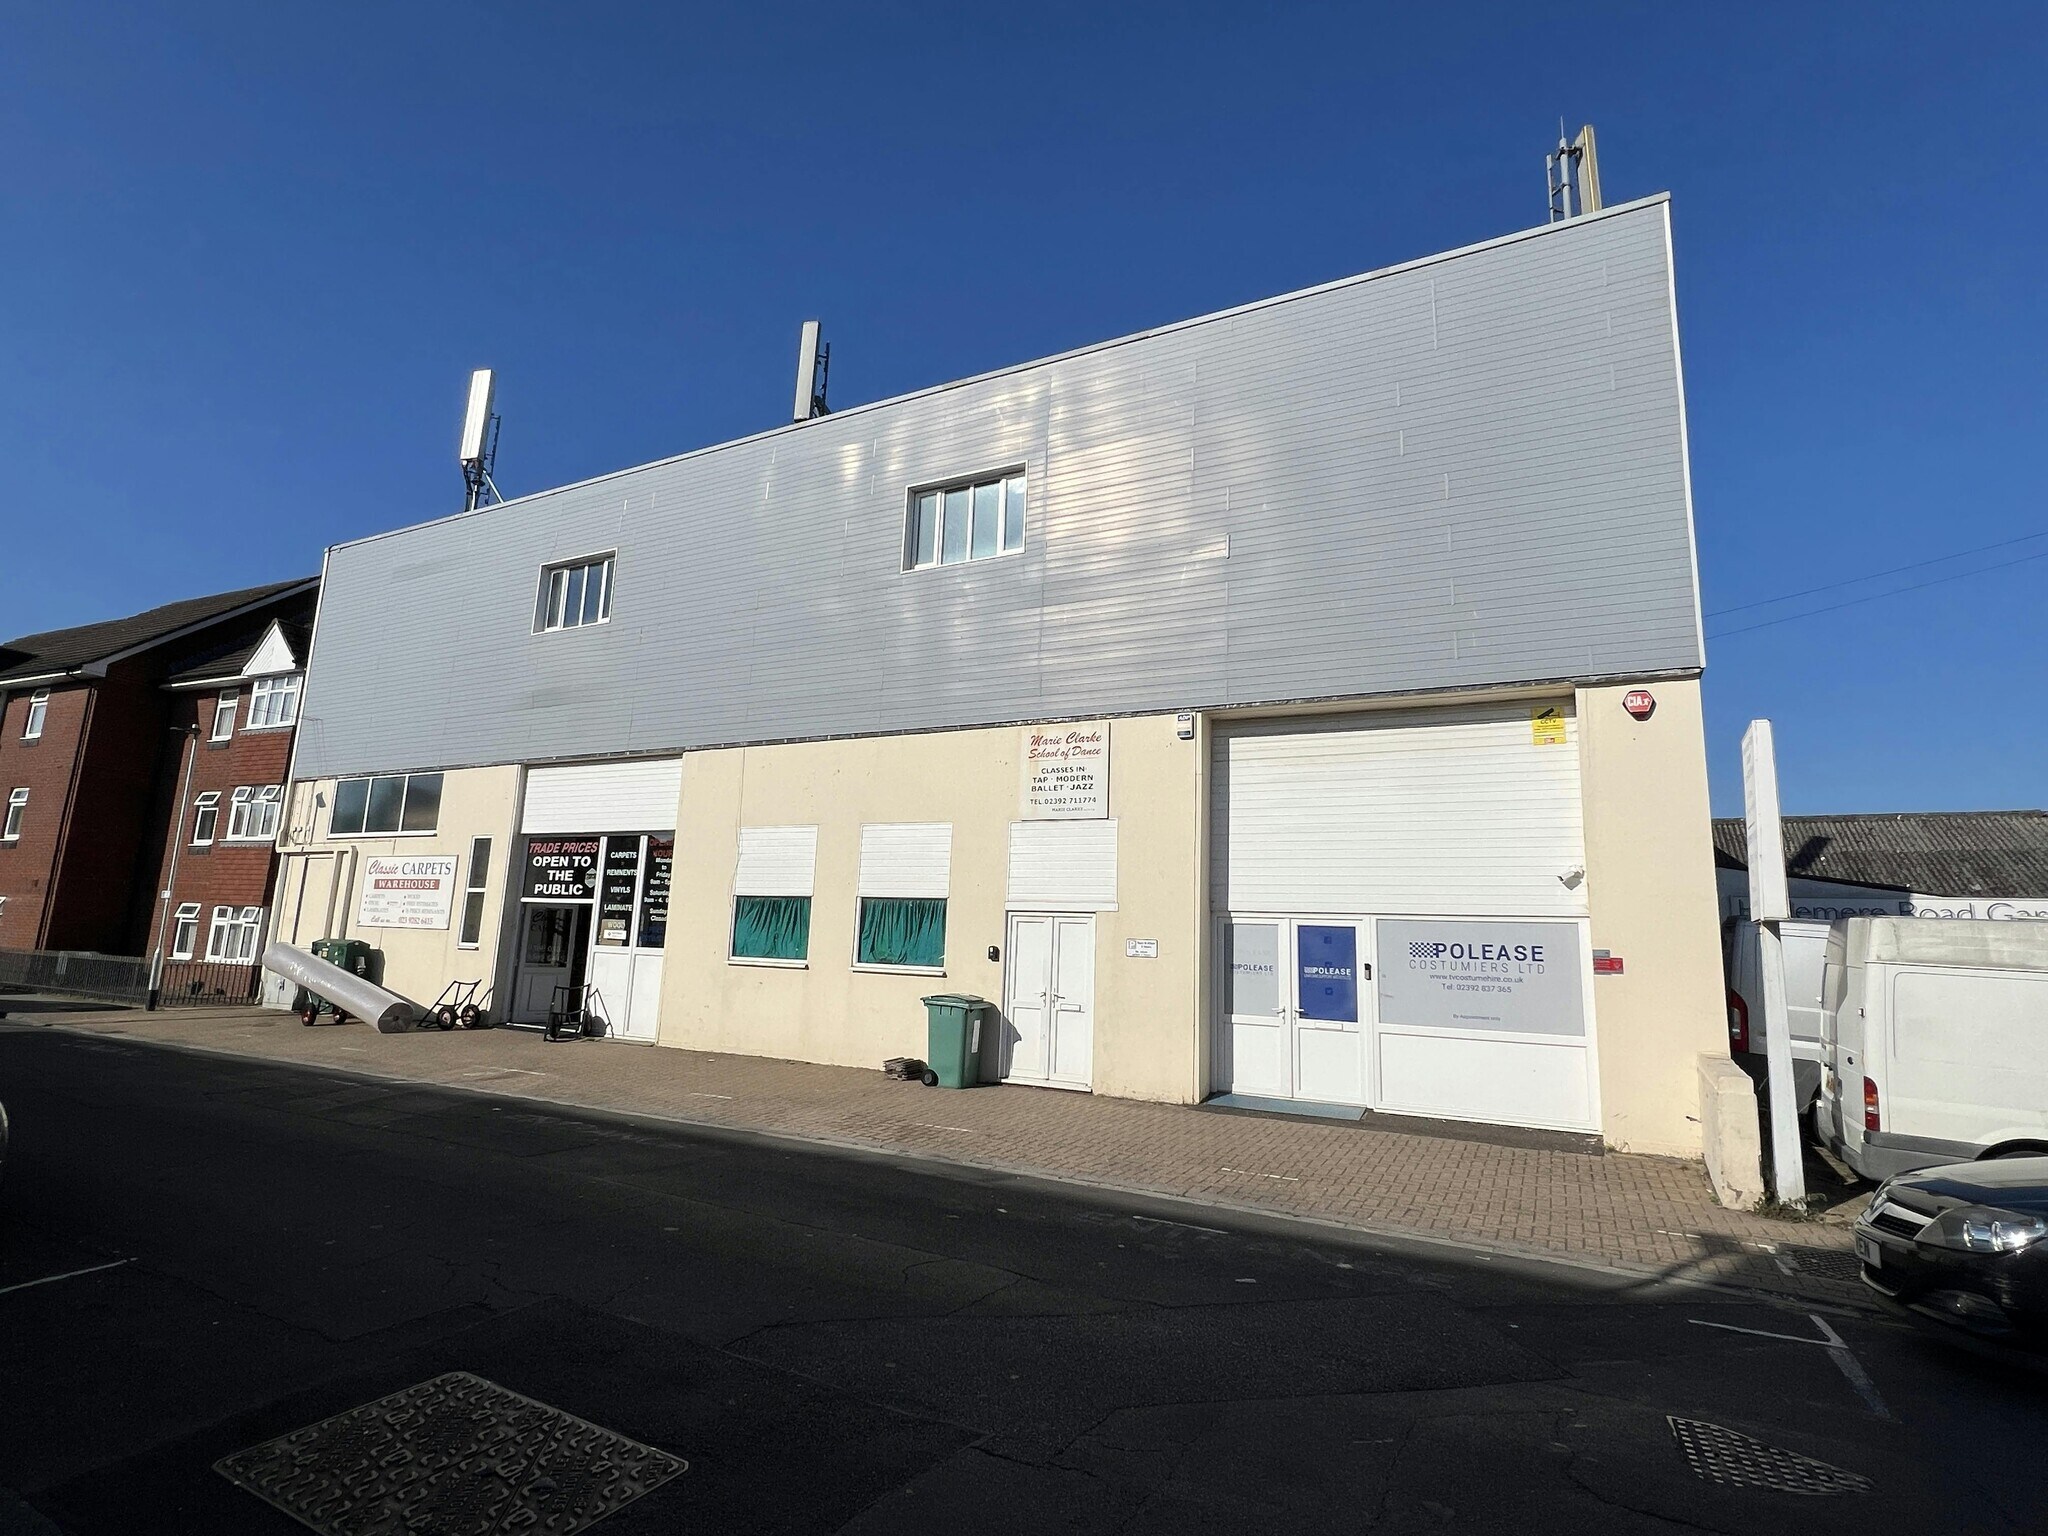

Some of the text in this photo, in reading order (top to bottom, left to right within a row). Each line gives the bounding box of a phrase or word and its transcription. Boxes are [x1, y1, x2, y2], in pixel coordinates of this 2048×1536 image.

[1030, 731, 1102, 747] Marie Clarke
[1028, 745, 1101, 760] School of Dance
[1041, 766, 1074, 774] CLASSES
[1056, 774, 1094, 782] MODERN
[1031, 784, 1064, 792] BALLET
[529, 842, 598, 853] TRADE PRICES
[610, 851, 637, 859] CARPETS
[532, 856, 592, 867] OPEN TO
[368, 860, 451, 875] Classic CARPETS
[547, 870, 574, 881] THE
[378, 880, 435, 889] WAREHOUSE
[534, 884, 583, 895] PUBLIC
[610, 886, 631, 894] VINYLS
[604, 903, 632, 912] LAMINATE
[1899, 901, 1976, 919] Road
[607, 922, 625, 930] WOOD
[1434, 942, 1544, 962] POLEASE
[1237, 963, 1274, 972] POLEASE
[1409, 959, 1545, 974] COSTUMIERS LTD
[1313, 967, 1351, 976] POLEASE
[1456, 984, 1480, 992] 02392
